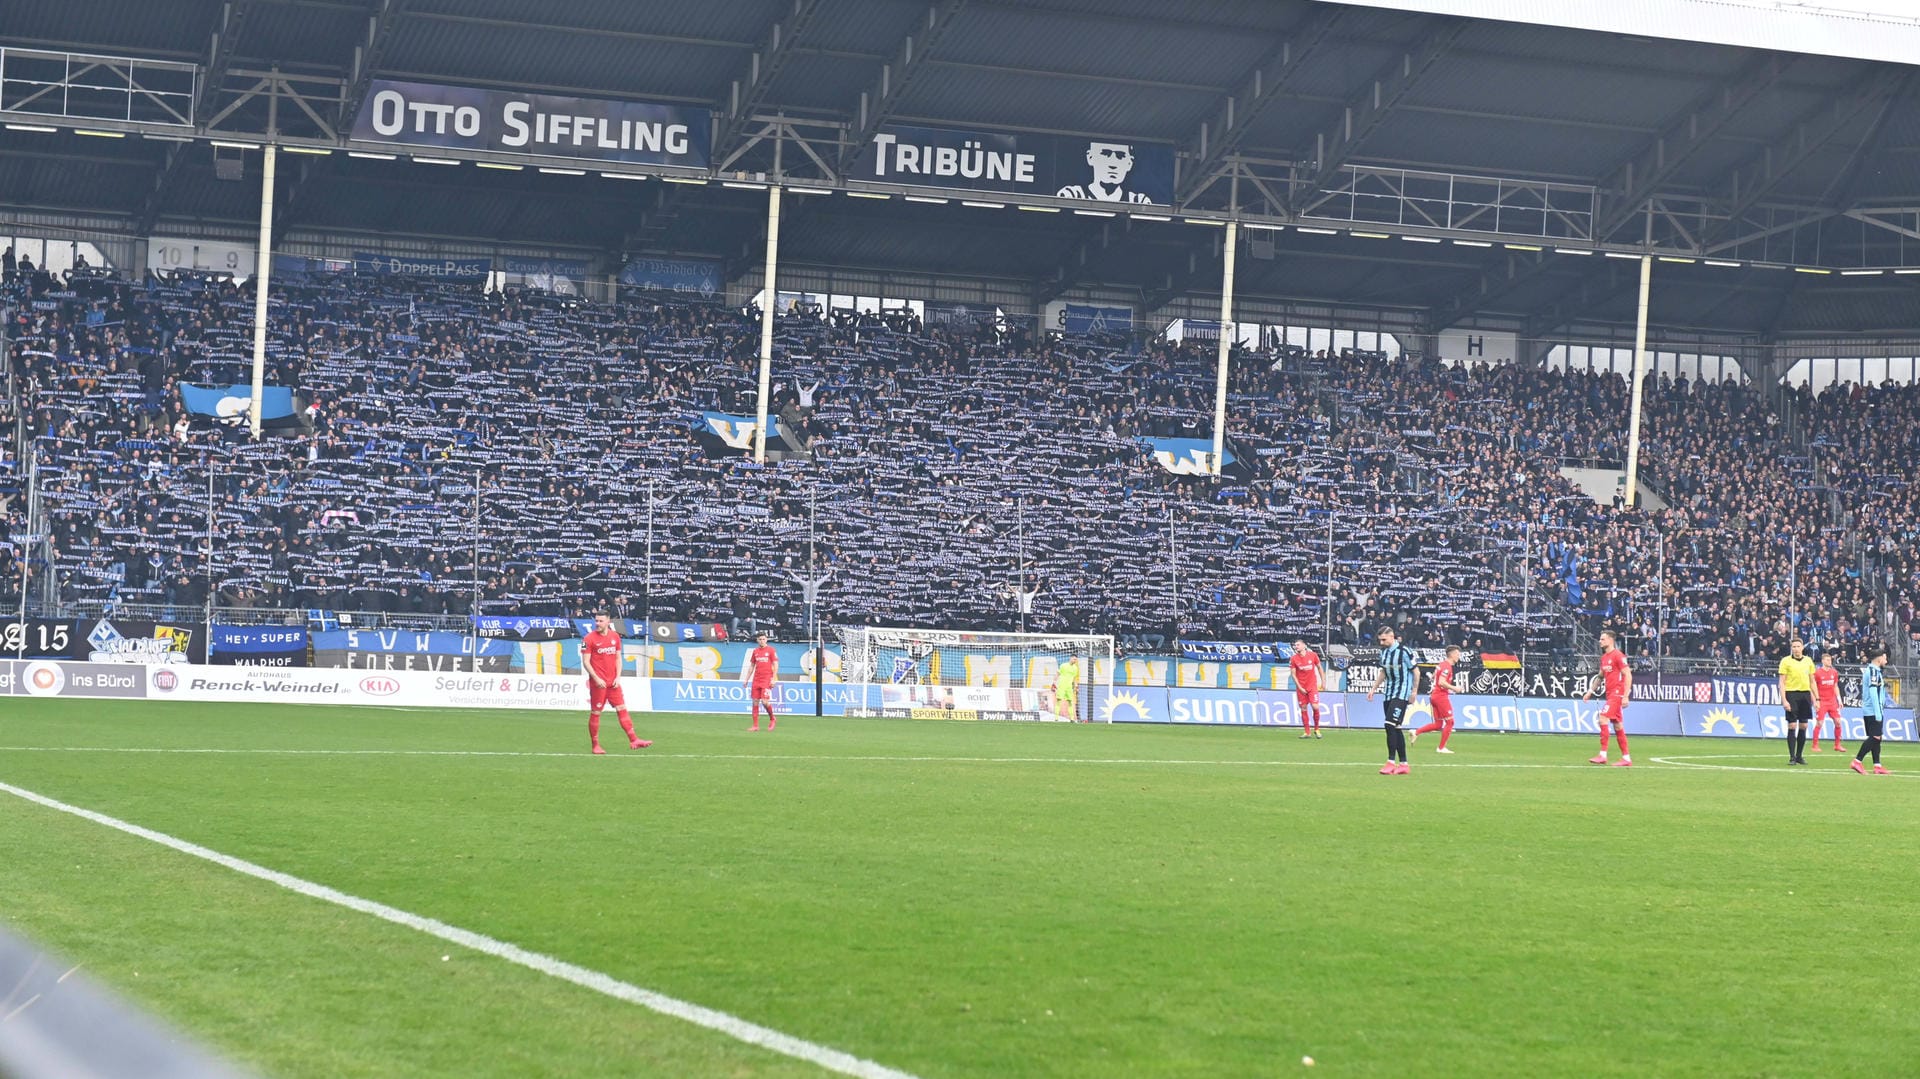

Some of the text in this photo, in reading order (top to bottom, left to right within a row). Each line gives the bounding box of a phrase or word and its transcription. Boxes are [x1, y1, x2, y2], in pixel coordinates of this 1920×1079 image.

[372, 90, 688, 154] OTTO SIFFLING
[872, 133, 1035, 183] TRIBÜNE
[158, 246, 239, 269] 10 L 9
[1467, 334, 1483, 357] H
[481, 619, 501, 629] KUR
[37, 625, 69, 651] 15
[225, 634, 249, 644] HEY
[261, 632, 301, 643] SUPER
[545, 629, 555, 638] 17
[1240, 645, 1273, 655] RAS
[72, 673, 135, 688] ins Büro!
[158, 674, 174, 686] FIAT
[366, 680, 394, 692] KIA
[435, 676, 578, 694] Seufert & Diemer
[1632, 684, 1694, 701] MANNHEIM
[882, 709, 906, 718] bwin
[913, 710, 976, 720] SPORTWETTEN
[983, 711, 1006, 721] bwin
